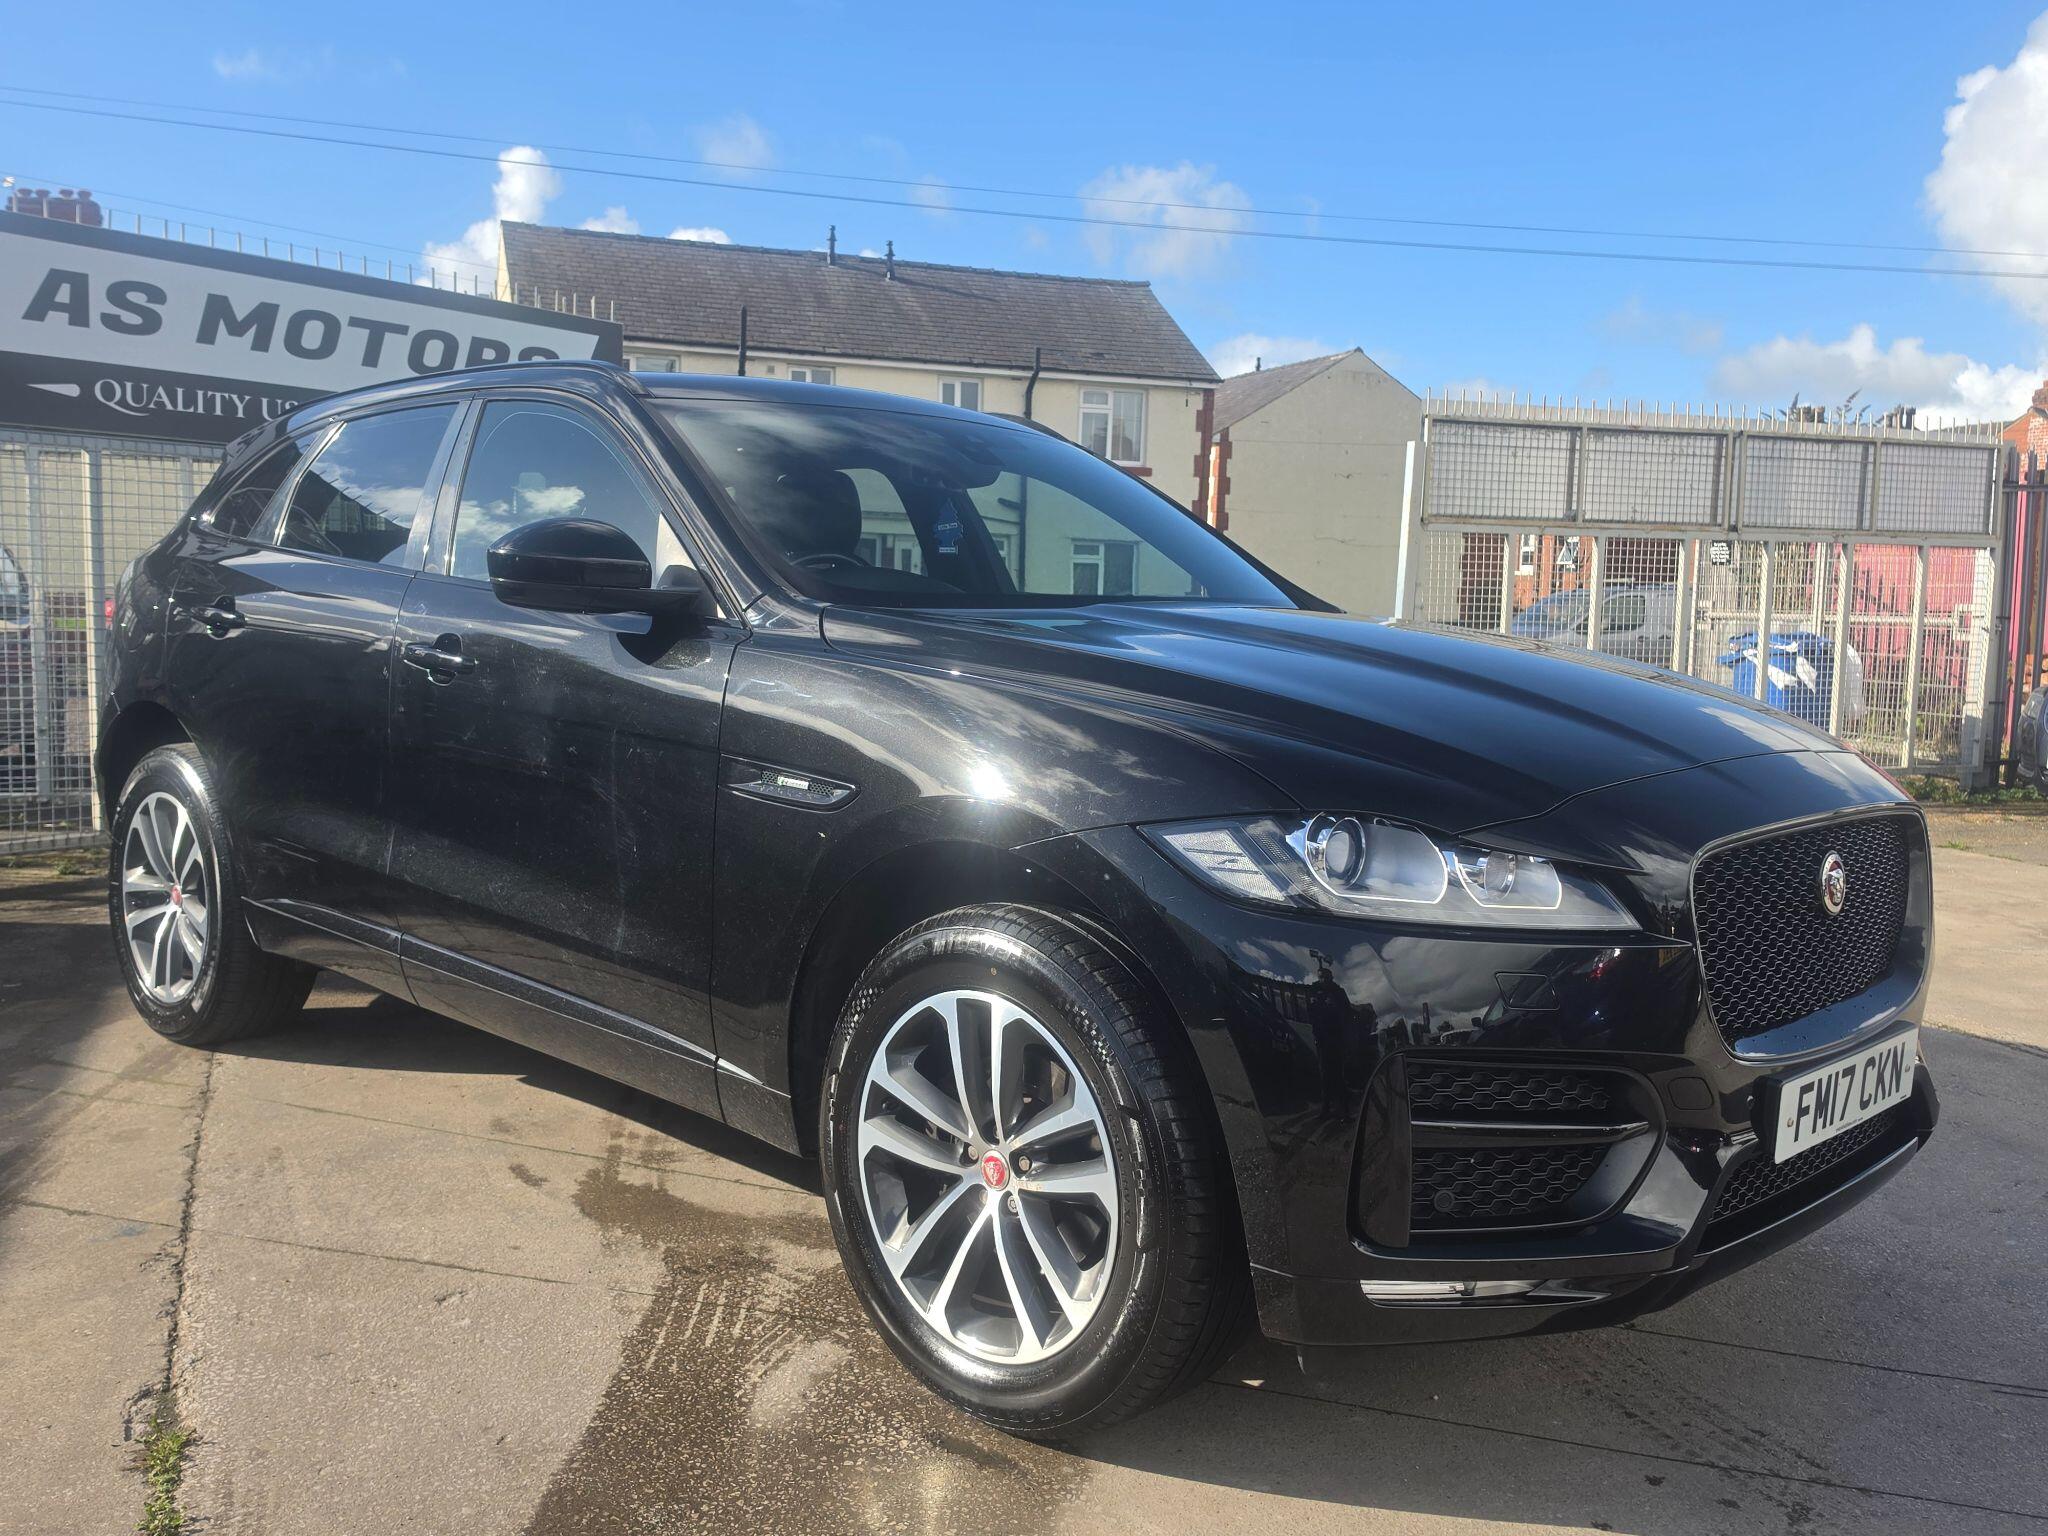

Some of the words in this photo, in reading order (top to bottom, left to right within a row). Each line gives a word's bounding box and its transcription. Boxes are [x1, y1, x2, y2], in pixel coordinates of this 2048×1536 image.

[21, 267, 168, 336] AS
[94, 378, 252, 418] QUALITY
[1793, 1063, 1857, 1143] FM17
[1859, 1041, 1906, 1111] CKN
